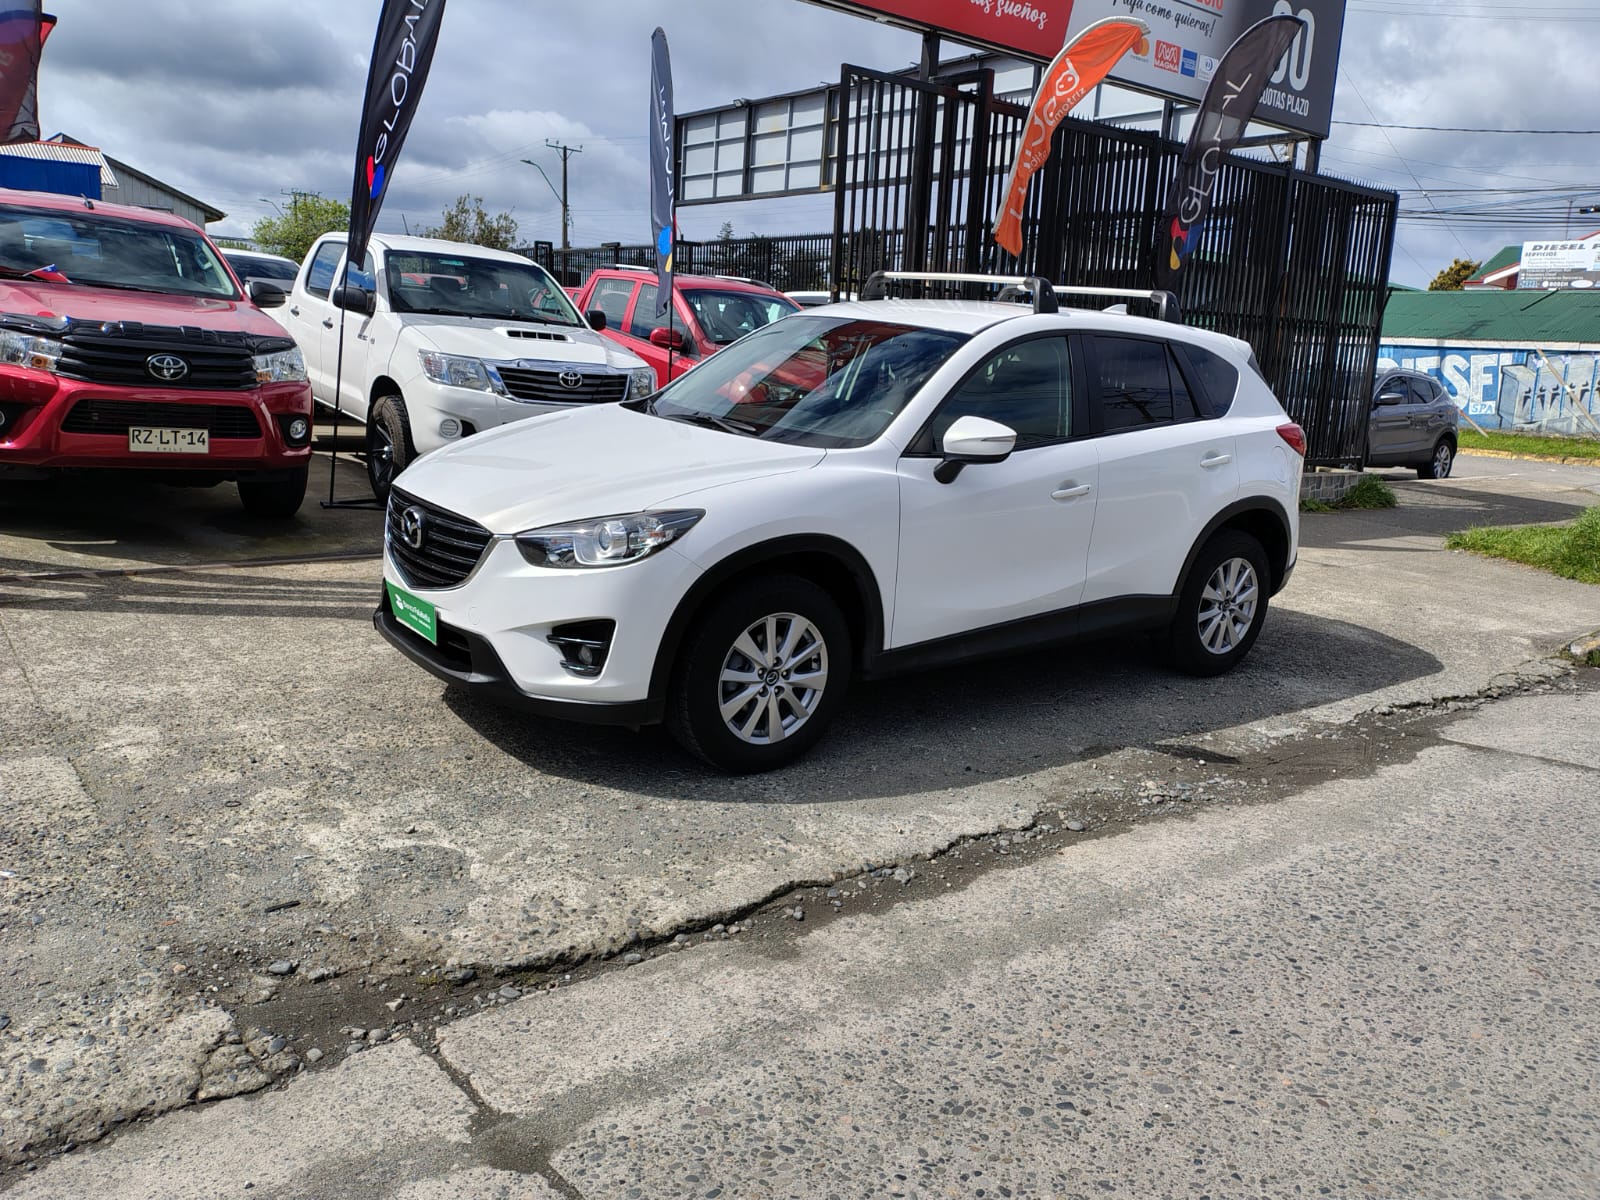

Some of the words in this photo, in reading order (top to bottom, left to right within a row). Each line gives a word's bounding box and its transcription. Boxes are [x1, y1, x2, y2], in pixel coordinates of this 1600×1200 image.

[994, 0, 1049, 30] sueños
[1145, 2, 1173, 20] como
[1174, 14, 1217, 38] quieras!
[1286, 95, 1310, 117] PLAZO
[1531, 243, 1586, 251] DIESEL
[1471, 404, 1494, 413] SPA
